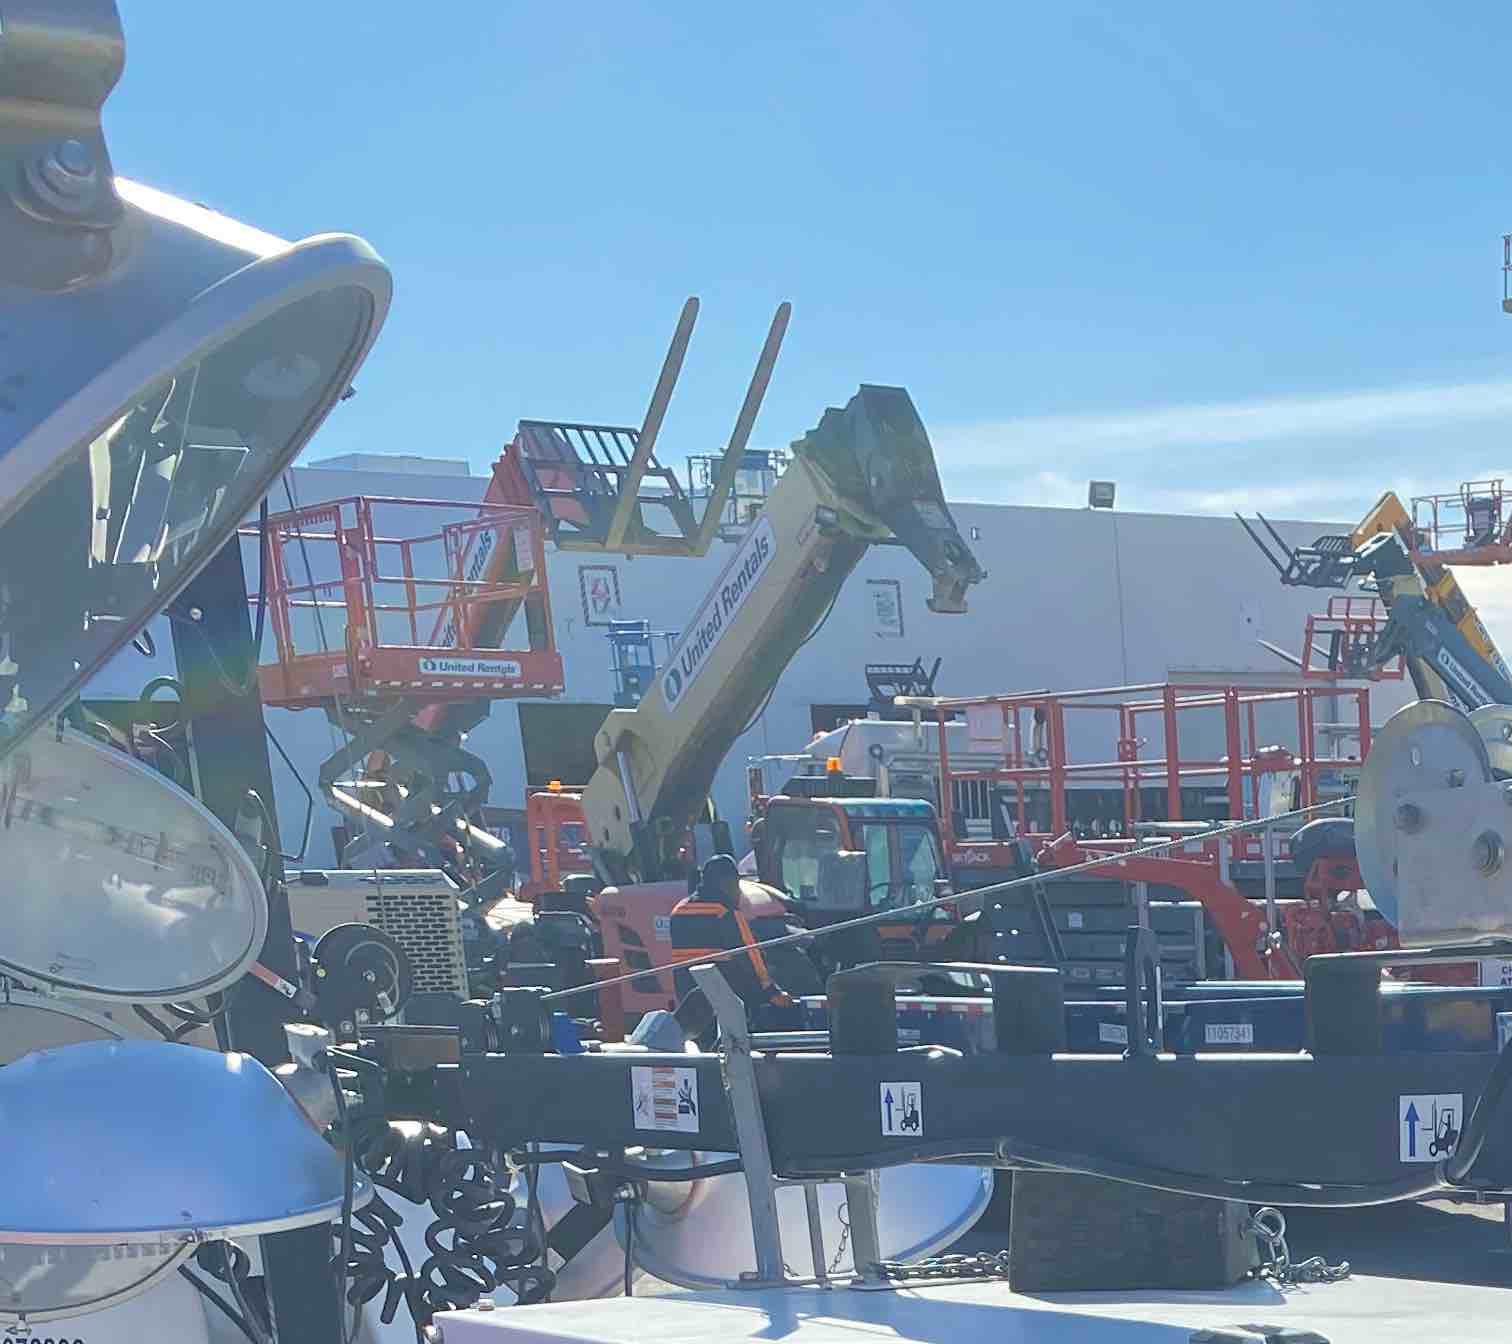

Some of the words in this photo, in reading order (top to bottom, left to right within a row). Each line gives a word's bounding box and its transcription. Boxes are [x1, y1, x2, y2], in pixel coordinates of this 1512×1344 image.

[681, 607, 723, 677] United
[721, 535, 769, 616] Rentals
[439, 660, 475, 673] United
[477, 661, 517, 674] Rentals
[1500, 977, 1512, 986] AT
